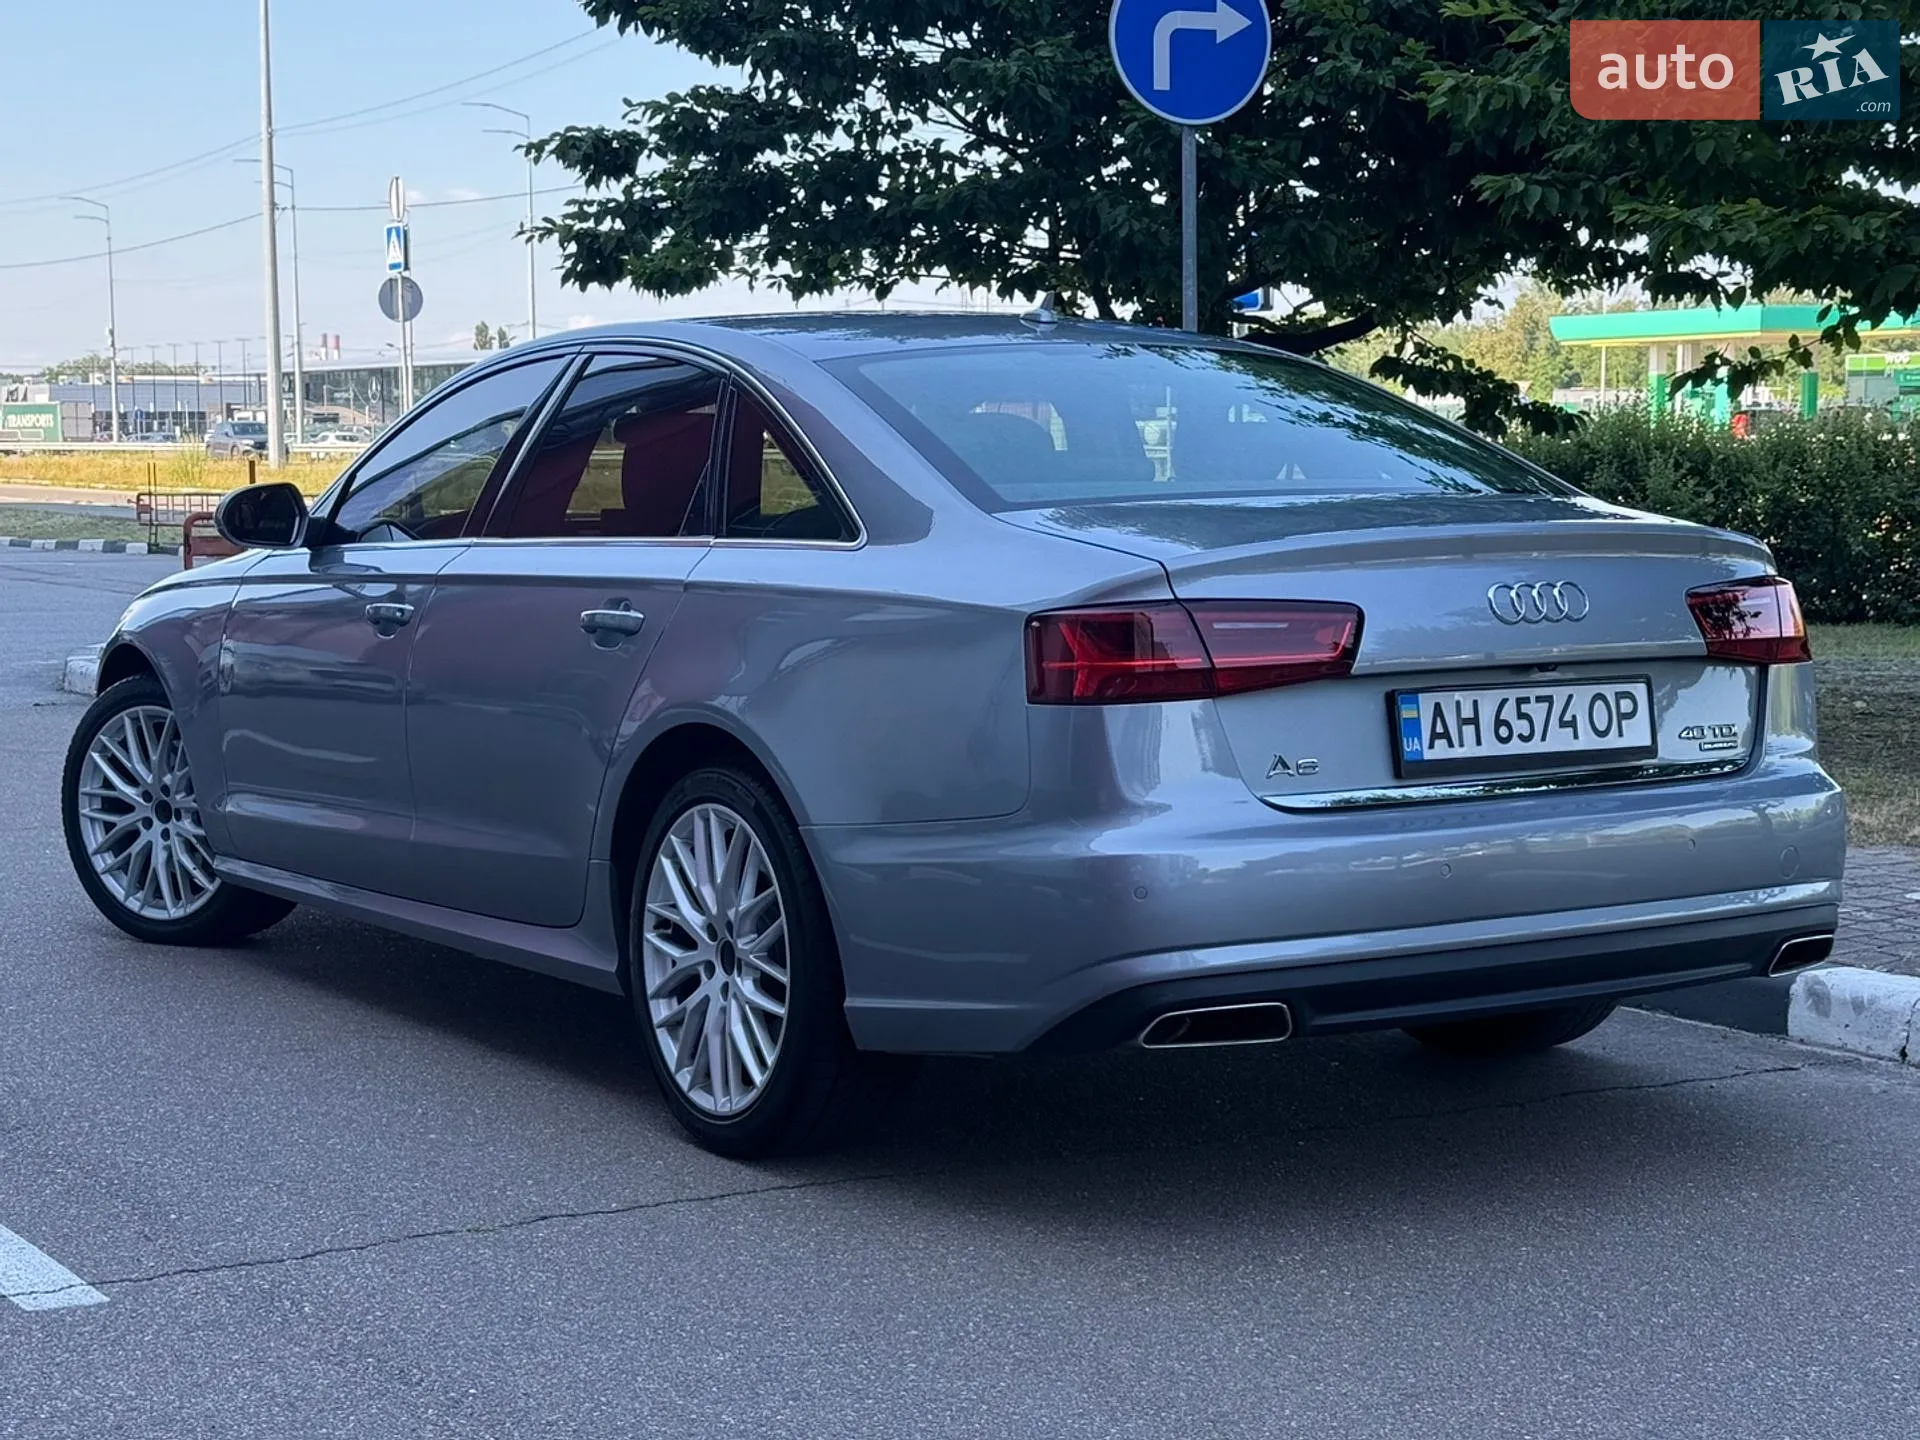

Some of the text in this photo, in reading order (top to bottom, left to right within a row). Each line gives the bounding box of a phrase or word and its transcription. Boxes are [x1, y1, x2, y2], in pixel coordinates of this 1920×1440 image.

[1427, 690, 1639, 750] AH 6574 OP
[1403, 736, 1421, 752] UA
[1265, 752, 1320, 779] A6
